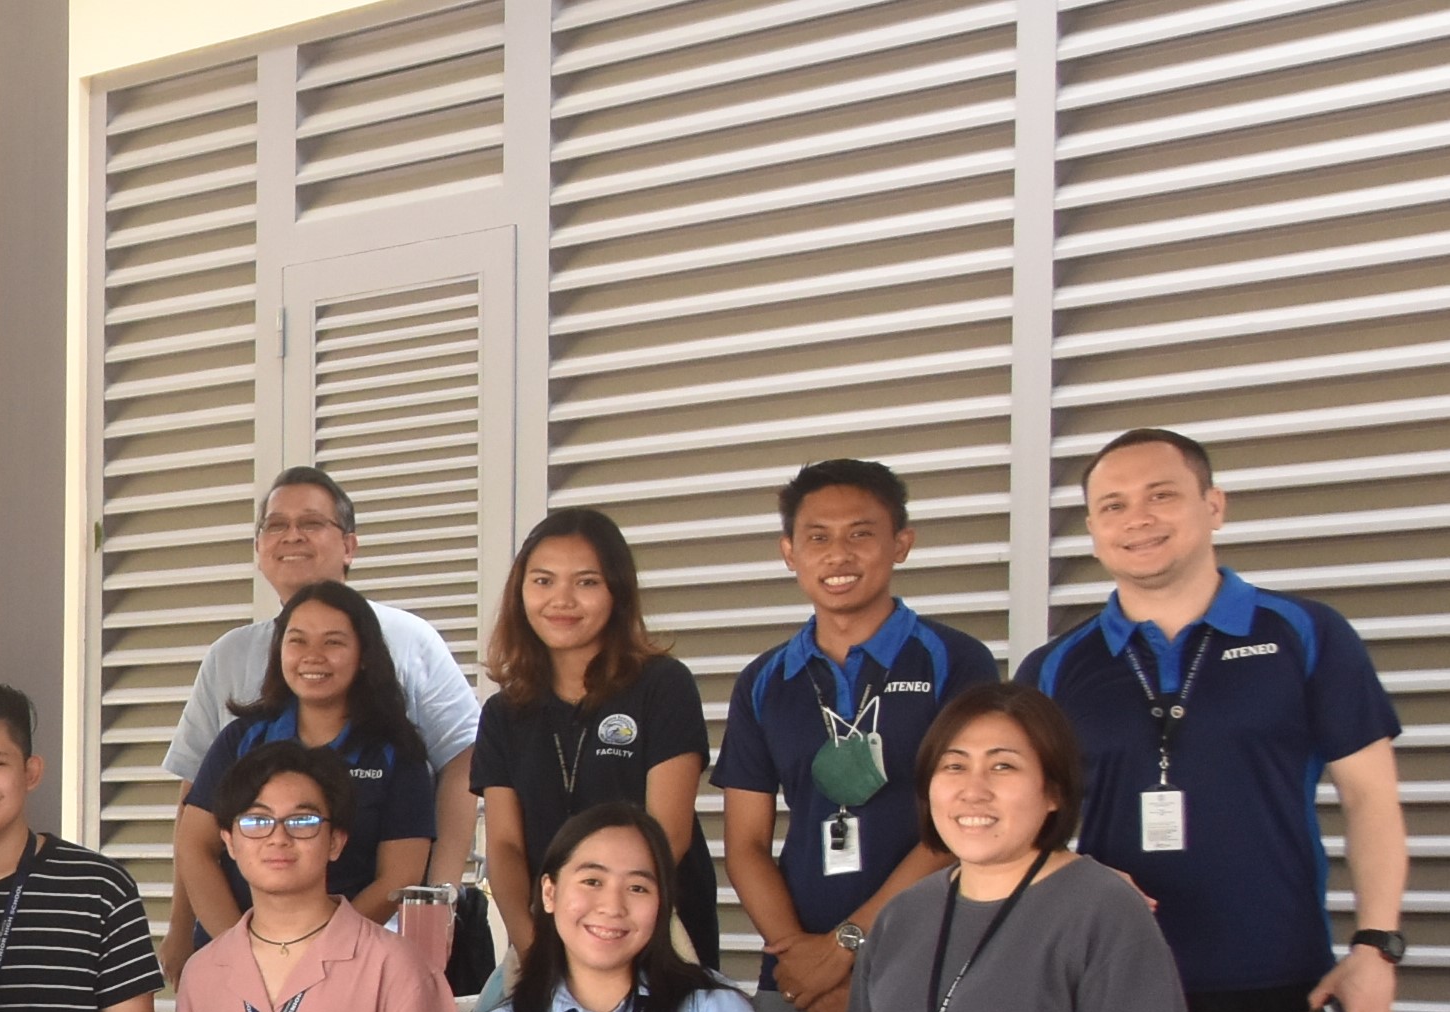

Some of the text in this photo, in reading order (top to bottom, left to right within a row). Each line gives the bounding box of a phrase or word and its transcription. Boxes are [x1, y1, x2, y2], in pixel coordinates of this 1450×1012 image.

[1221, 642, 1279, 661] ATENEO
[884, 681, 931, 693] ATENEO
[596, 748, 634, 758] FACULTY
[4, 917, 13, 935] HIGH
[10, 885, 23, 915] SCHOOL
